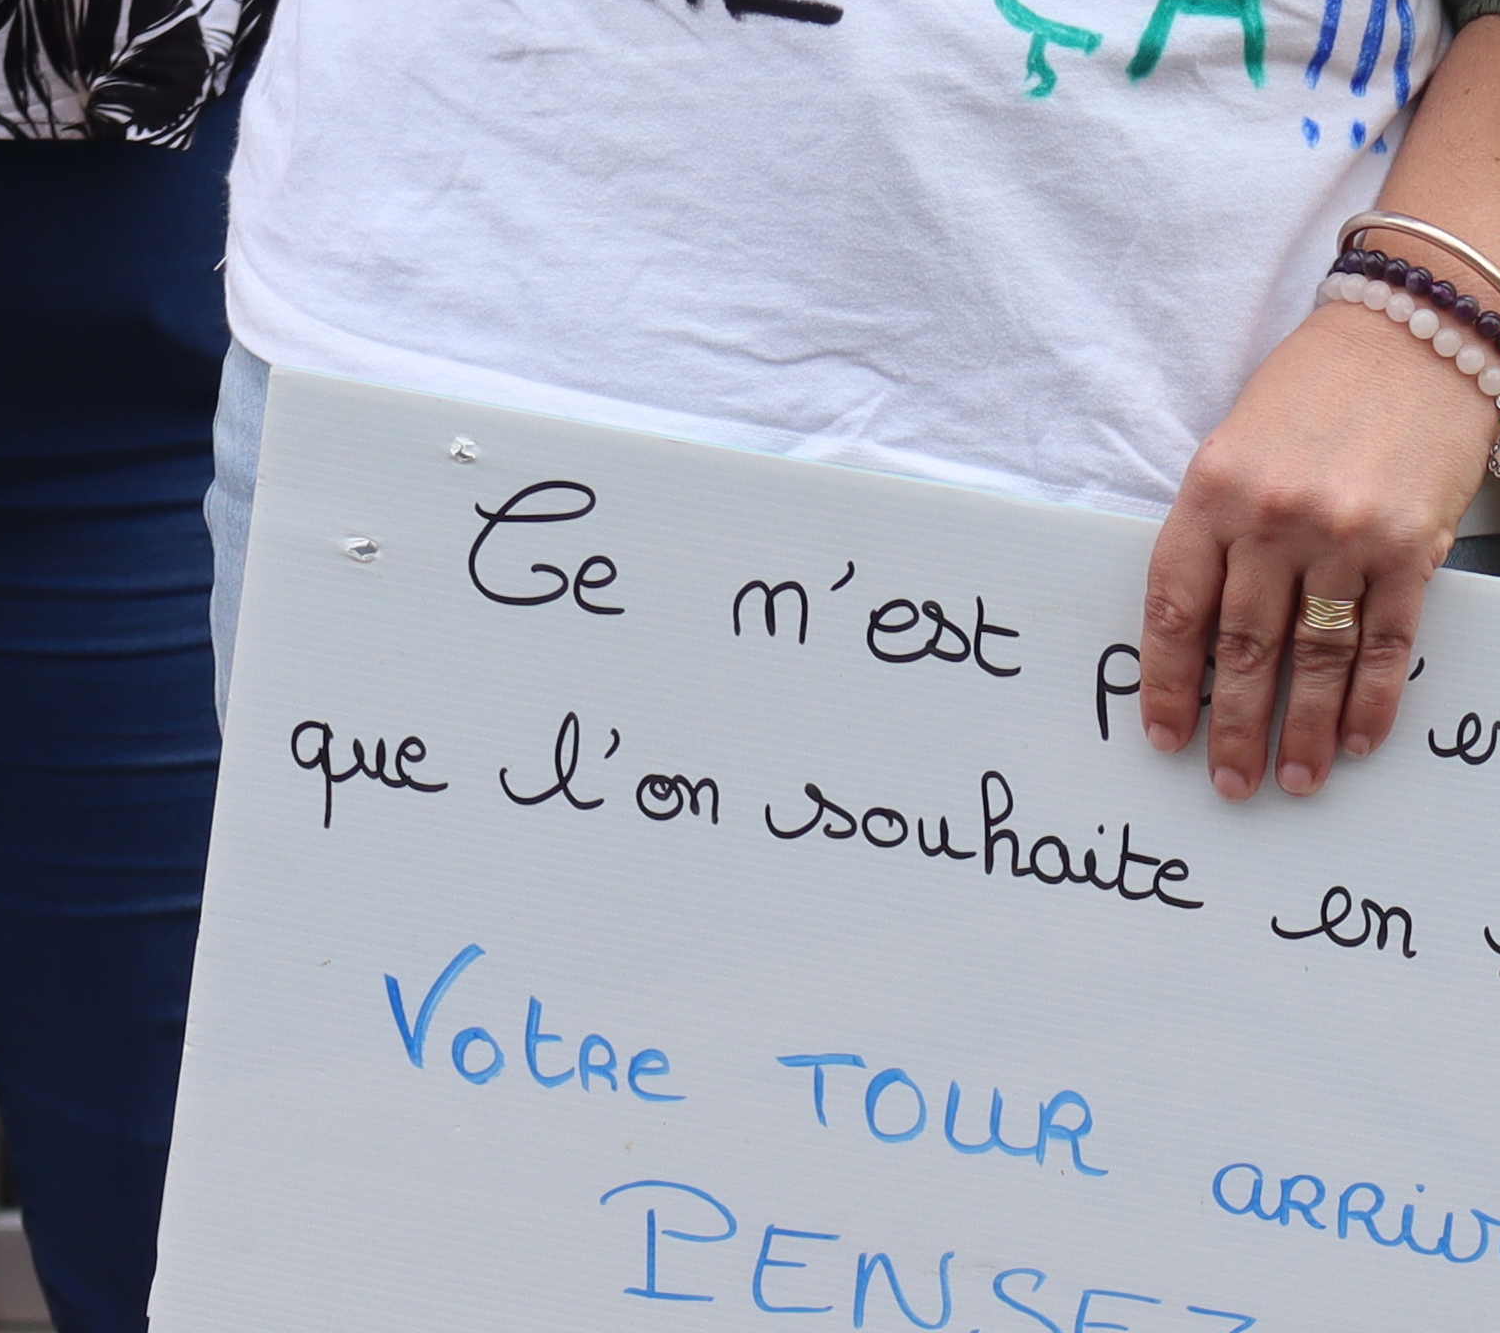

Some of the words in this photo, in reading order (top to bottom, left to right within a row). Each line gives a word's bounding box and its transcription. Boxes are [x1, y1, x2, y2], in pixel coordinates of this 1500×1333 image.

[468, 480, 625, 615] Ce
[291, 720, 449, 829] que
[499, 711, 719, 825] l'on
[765, 770, 1204, 909] souhaite
[1271, 885, 1417, 959] en
[775, 1052, 1110, 1177] TOUR
[599, 1178, 1260, 1333] PENSE
